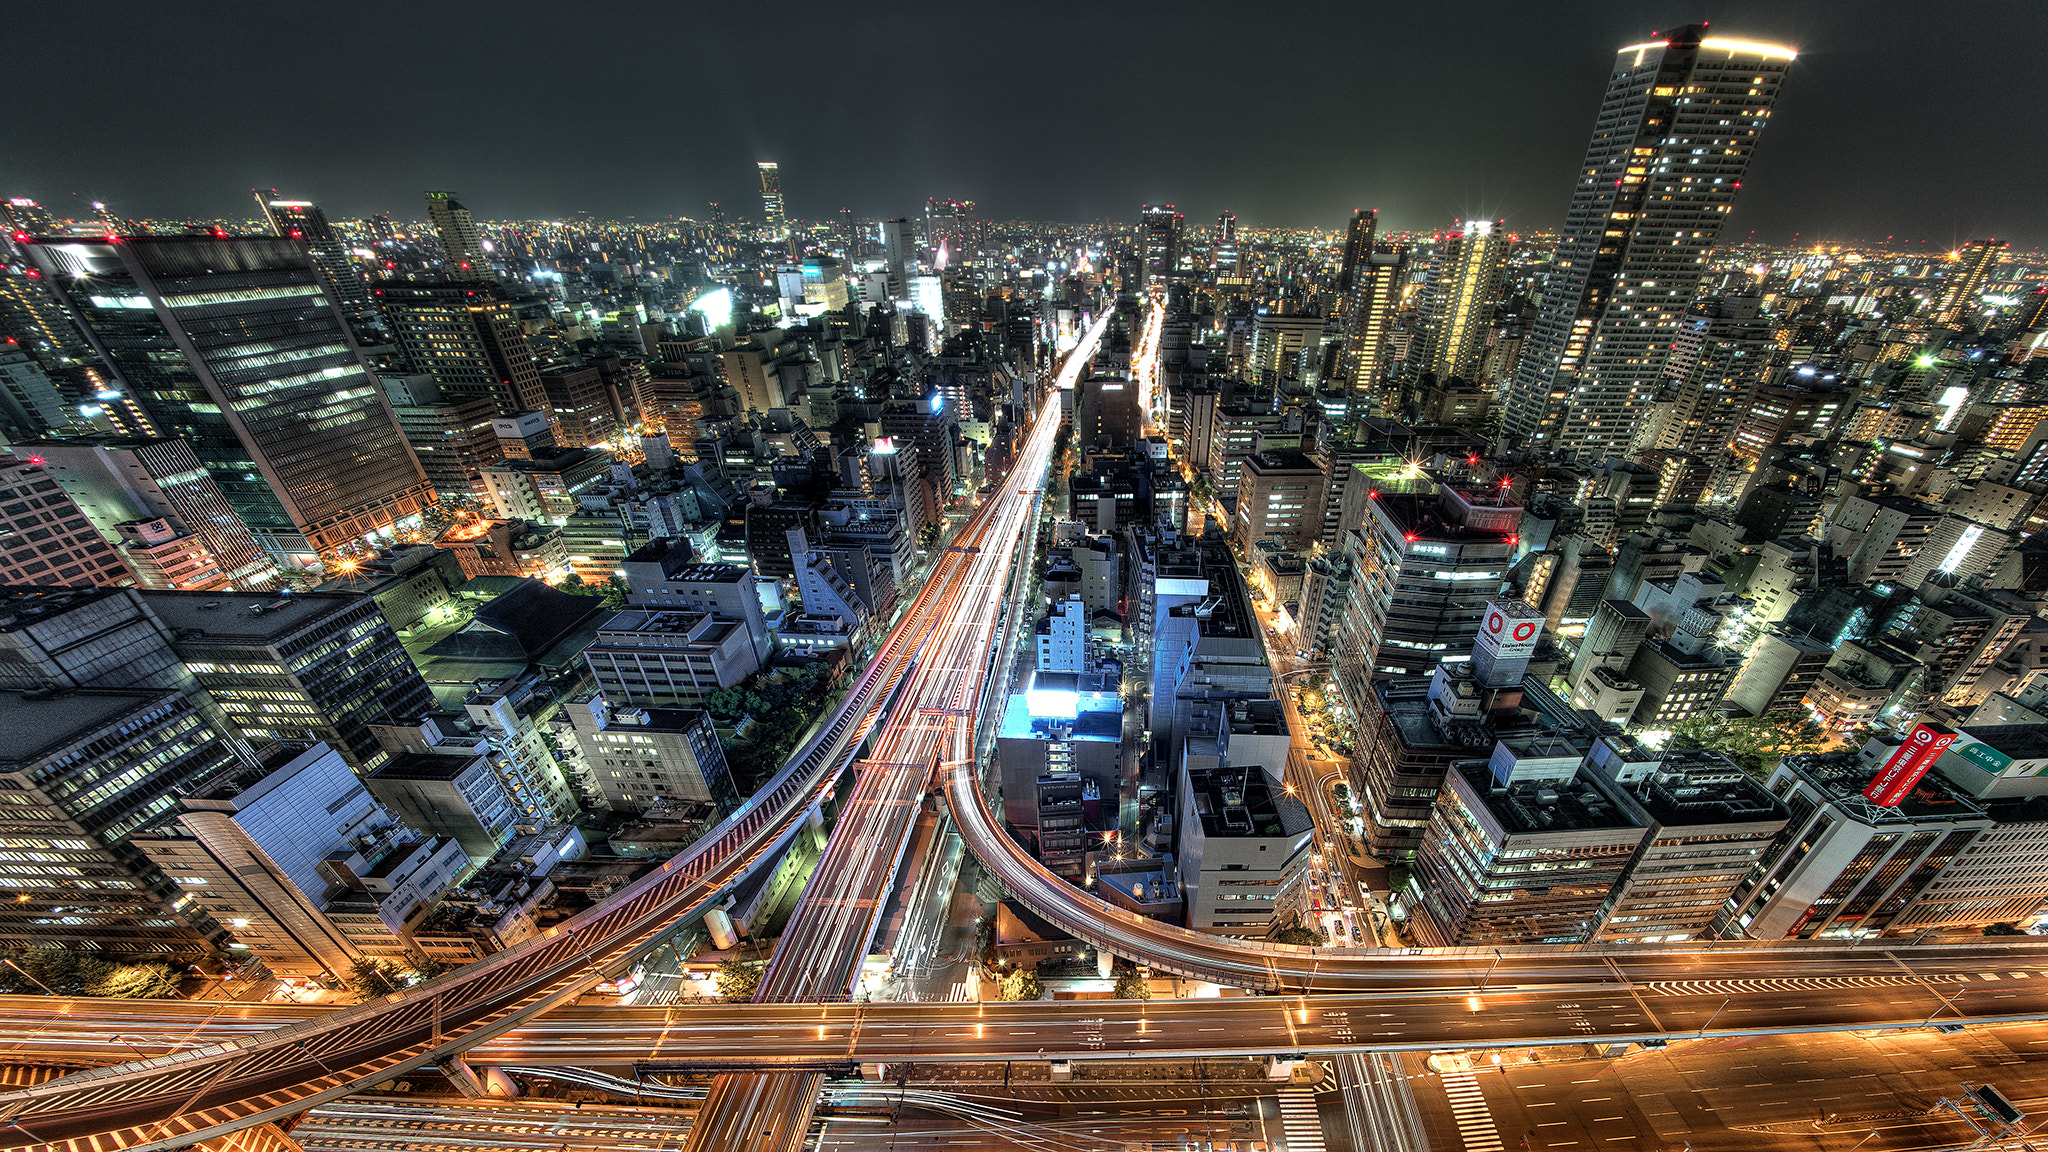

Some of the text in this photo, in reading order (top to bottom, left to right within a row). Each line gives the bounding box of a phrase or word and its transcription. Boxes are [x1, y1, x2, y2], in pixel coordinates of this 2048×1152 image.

[1870, 745, 1918, 799] 三菱東京UFJ銀行
[1969, 747, 2001, 768] 商工中金
